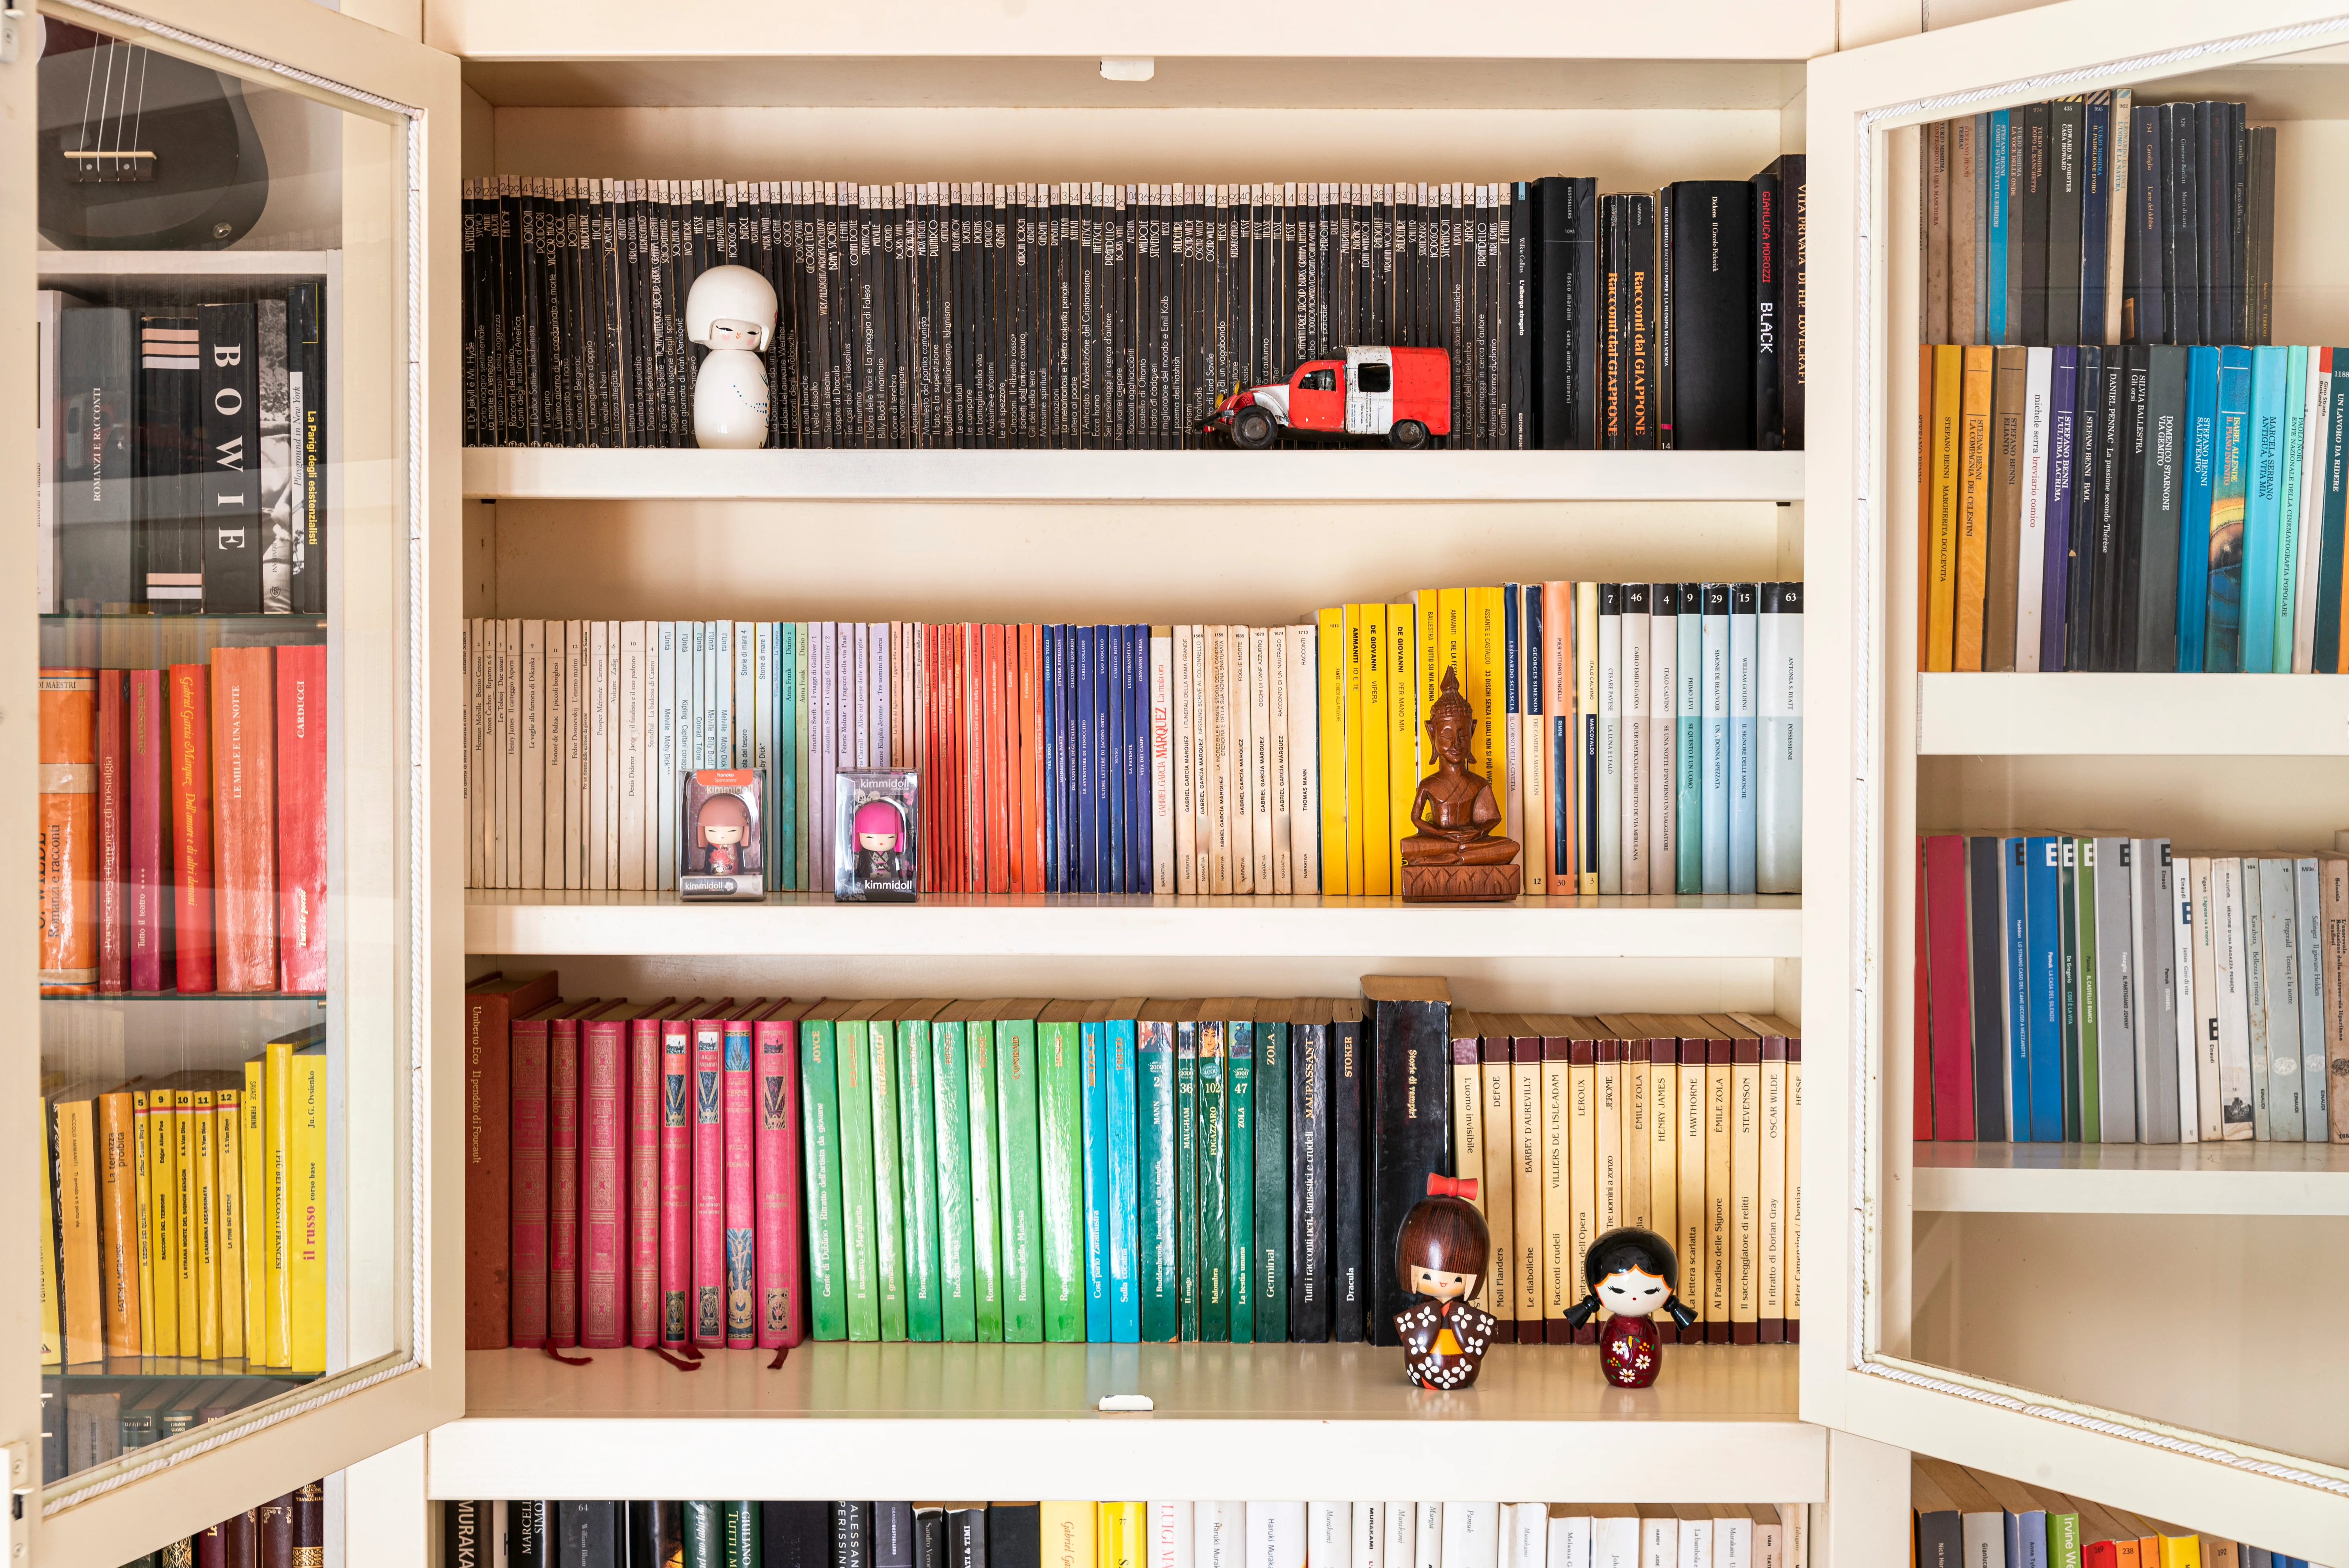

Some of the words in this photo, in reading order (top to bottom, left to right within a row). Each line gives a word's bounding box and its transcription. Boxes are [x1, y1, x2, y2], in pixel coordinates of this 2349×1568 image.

[536, 212, 545, 253] POLIDORI
[567, 214, 577, 247] ROSTAND
[929, 220, 939, 257] PLUTARCO
[952, 219, 960, 251] BULGAKOV
[1070, 221, 1079, 240] KAFKA
[1093, 222, 1102, 253] NIETZSCHE
[1139, 220, 1148, 253] WALPOLE
[1477, 223, 1487, 266] PIRANDELLO
[1634, 272, 1645, 331] Racconti
[1760, 303, 1773, 353] BLACK
[1635, 334, 1645, 356] dal
[572, 355, 583, 390] Bergerac
[543, 391, 552, 421] vampiro
[954, 384, 963, 402] fatali
[1635, 359, 1645, 436] GIAPPONE
[2338, 393, 2344, 406] UN
[308, 411, 317, 423] La
[876, 401, 885, 421] Budd
[2034, 394, 2042, 428] michele
[295, 428, 301, 436] in
[306, 425, 317, 452] Parigi
[877, 423, 887, 438] Billy
[214, 343, 245, 550] BOWIE
[293, 438, 302, 486] Playground
[2335, 445, 2341, 457] DA
[92, 453, 101, 501] ROMANZI
[306, 455, 317, 478] degli
[2031, 457, 2040, 496] breviario
[308, 480, 317, 545] esistenzialisti
[1785, 593, 1796, 601] 63
[1370, 625, 1376, 634] DE
[297, 681, 305, 738] CARDUCCI
[1157, 694, 1164, 702] La
[1155, 706, 1169, 759] MÁRQUEZ
[233, 752, 241, 783] MILLE
[1156, 760, 1166, 787] GARCÍA
[234, 785, 242, 798] LE
[860, 779, 909, 788] kimmidoll
[865, 879, 912, 890] kimmidoll
[812, 1030, 821, 1063] JOYCE
[1267, 1033, 1275, 1065] ZOLA
[1344, 1036, 1352, 1077] STOKER
[1234, 1083, 1248, 1094] 47
[308, 1106, 315, 1115] G.
[306, 1206, 315, 1245] russo
[303, 1250, 315, 1260] il
[1266, 1249, 1275, 1298] Germinal
[1239, 1295, 1246, 1304] La
[2095, 1546, 2104, 1554] 169
